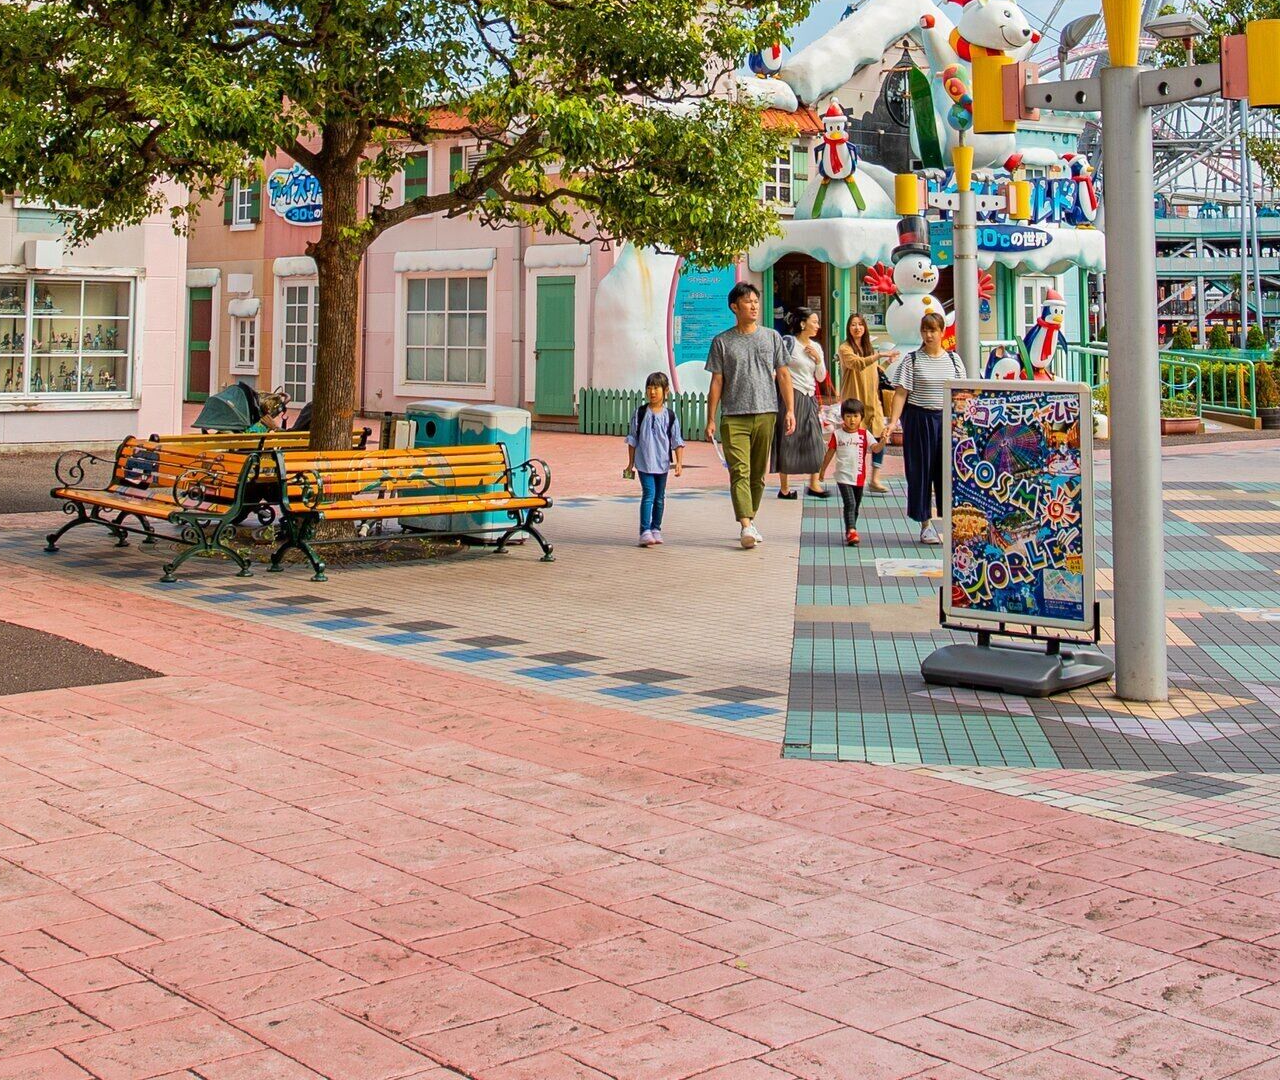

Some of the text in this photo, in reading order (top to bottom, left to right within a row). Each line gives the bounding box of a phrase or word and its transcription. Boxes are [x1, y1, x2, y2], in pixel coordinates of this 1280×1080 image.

[1008, 392, 1045, 402] YOKOHAMA
[972, 400, 1079, 427] コスモワールド
[959, 526, 1080, 604] WORLD
